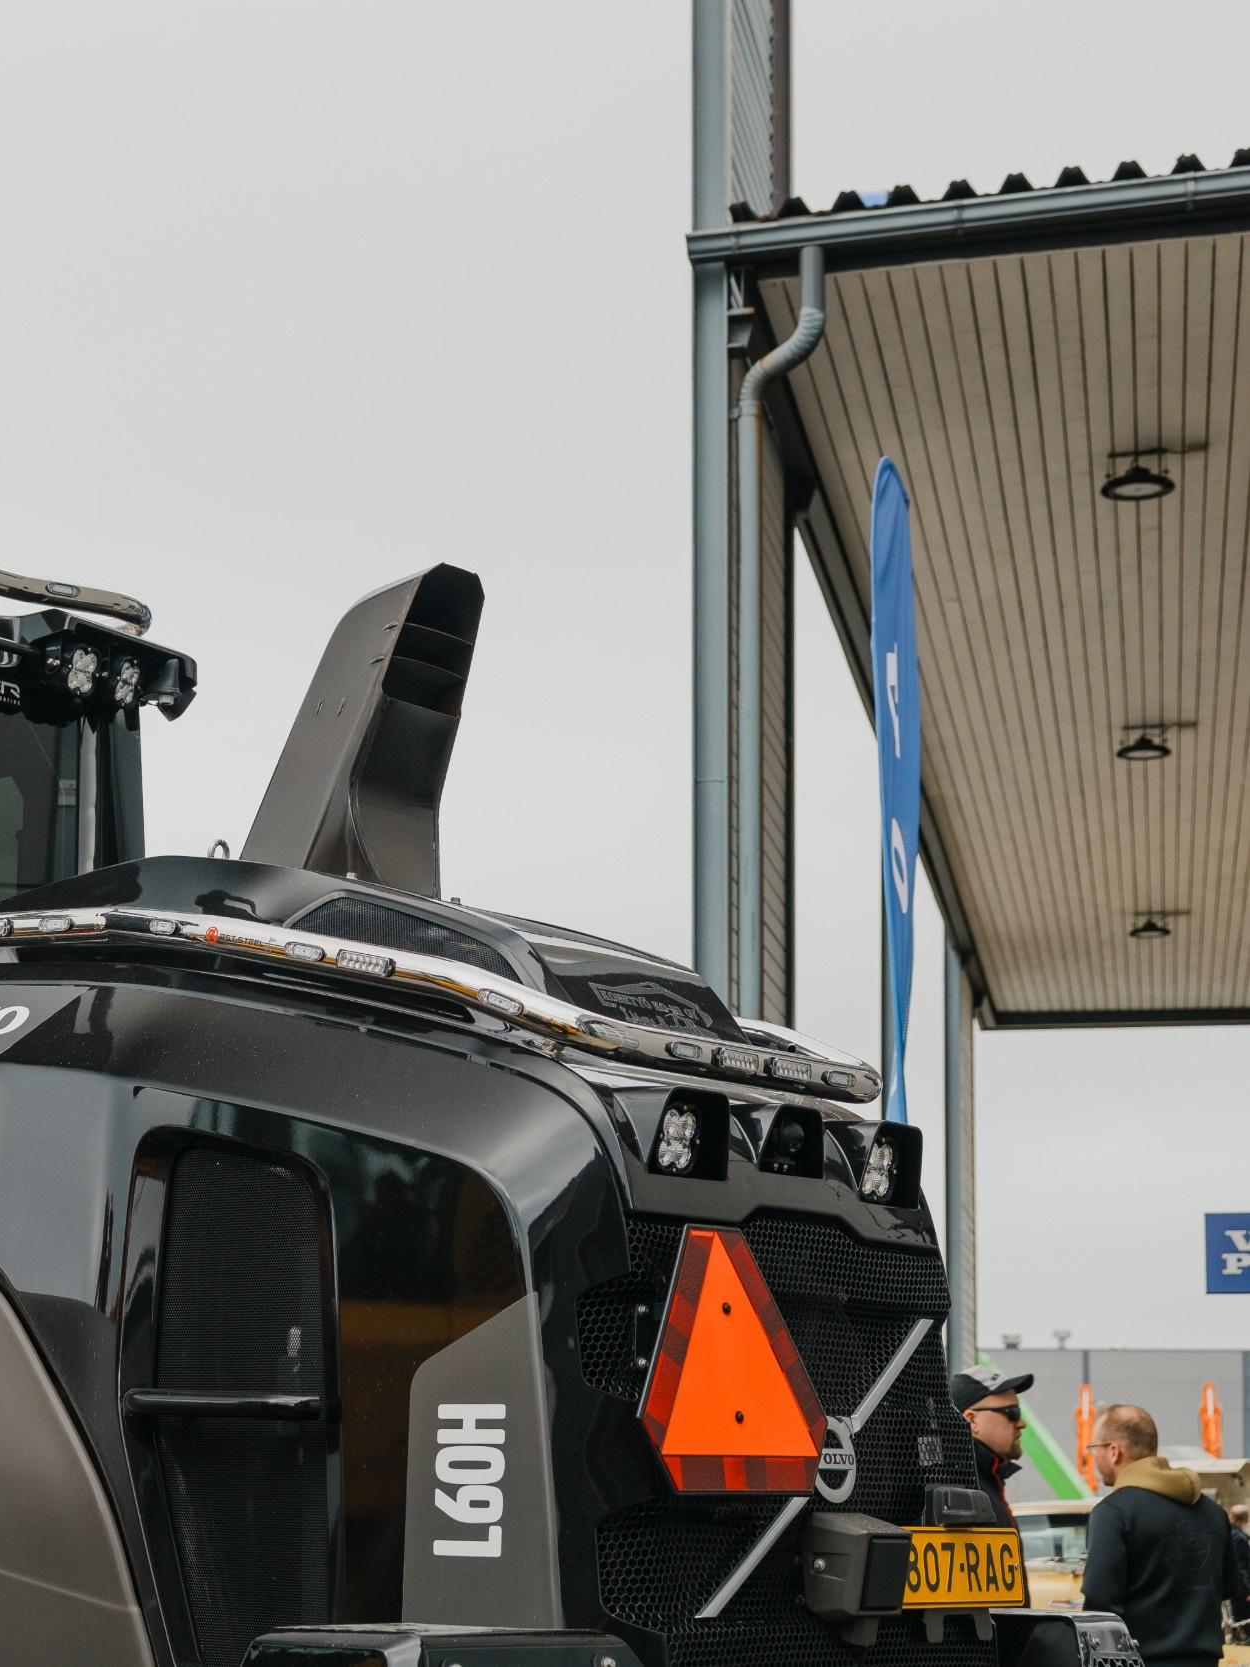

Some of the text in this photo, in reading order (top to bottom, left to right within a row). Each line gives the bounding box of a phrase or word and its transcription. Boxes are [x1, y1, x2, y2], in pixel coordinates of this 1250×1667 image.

[433, 1403, 506, 1558] L60H
[822, 1453, 855, 1466] OLVO
[906, 1541, 1016, 1593] 807-RAG
